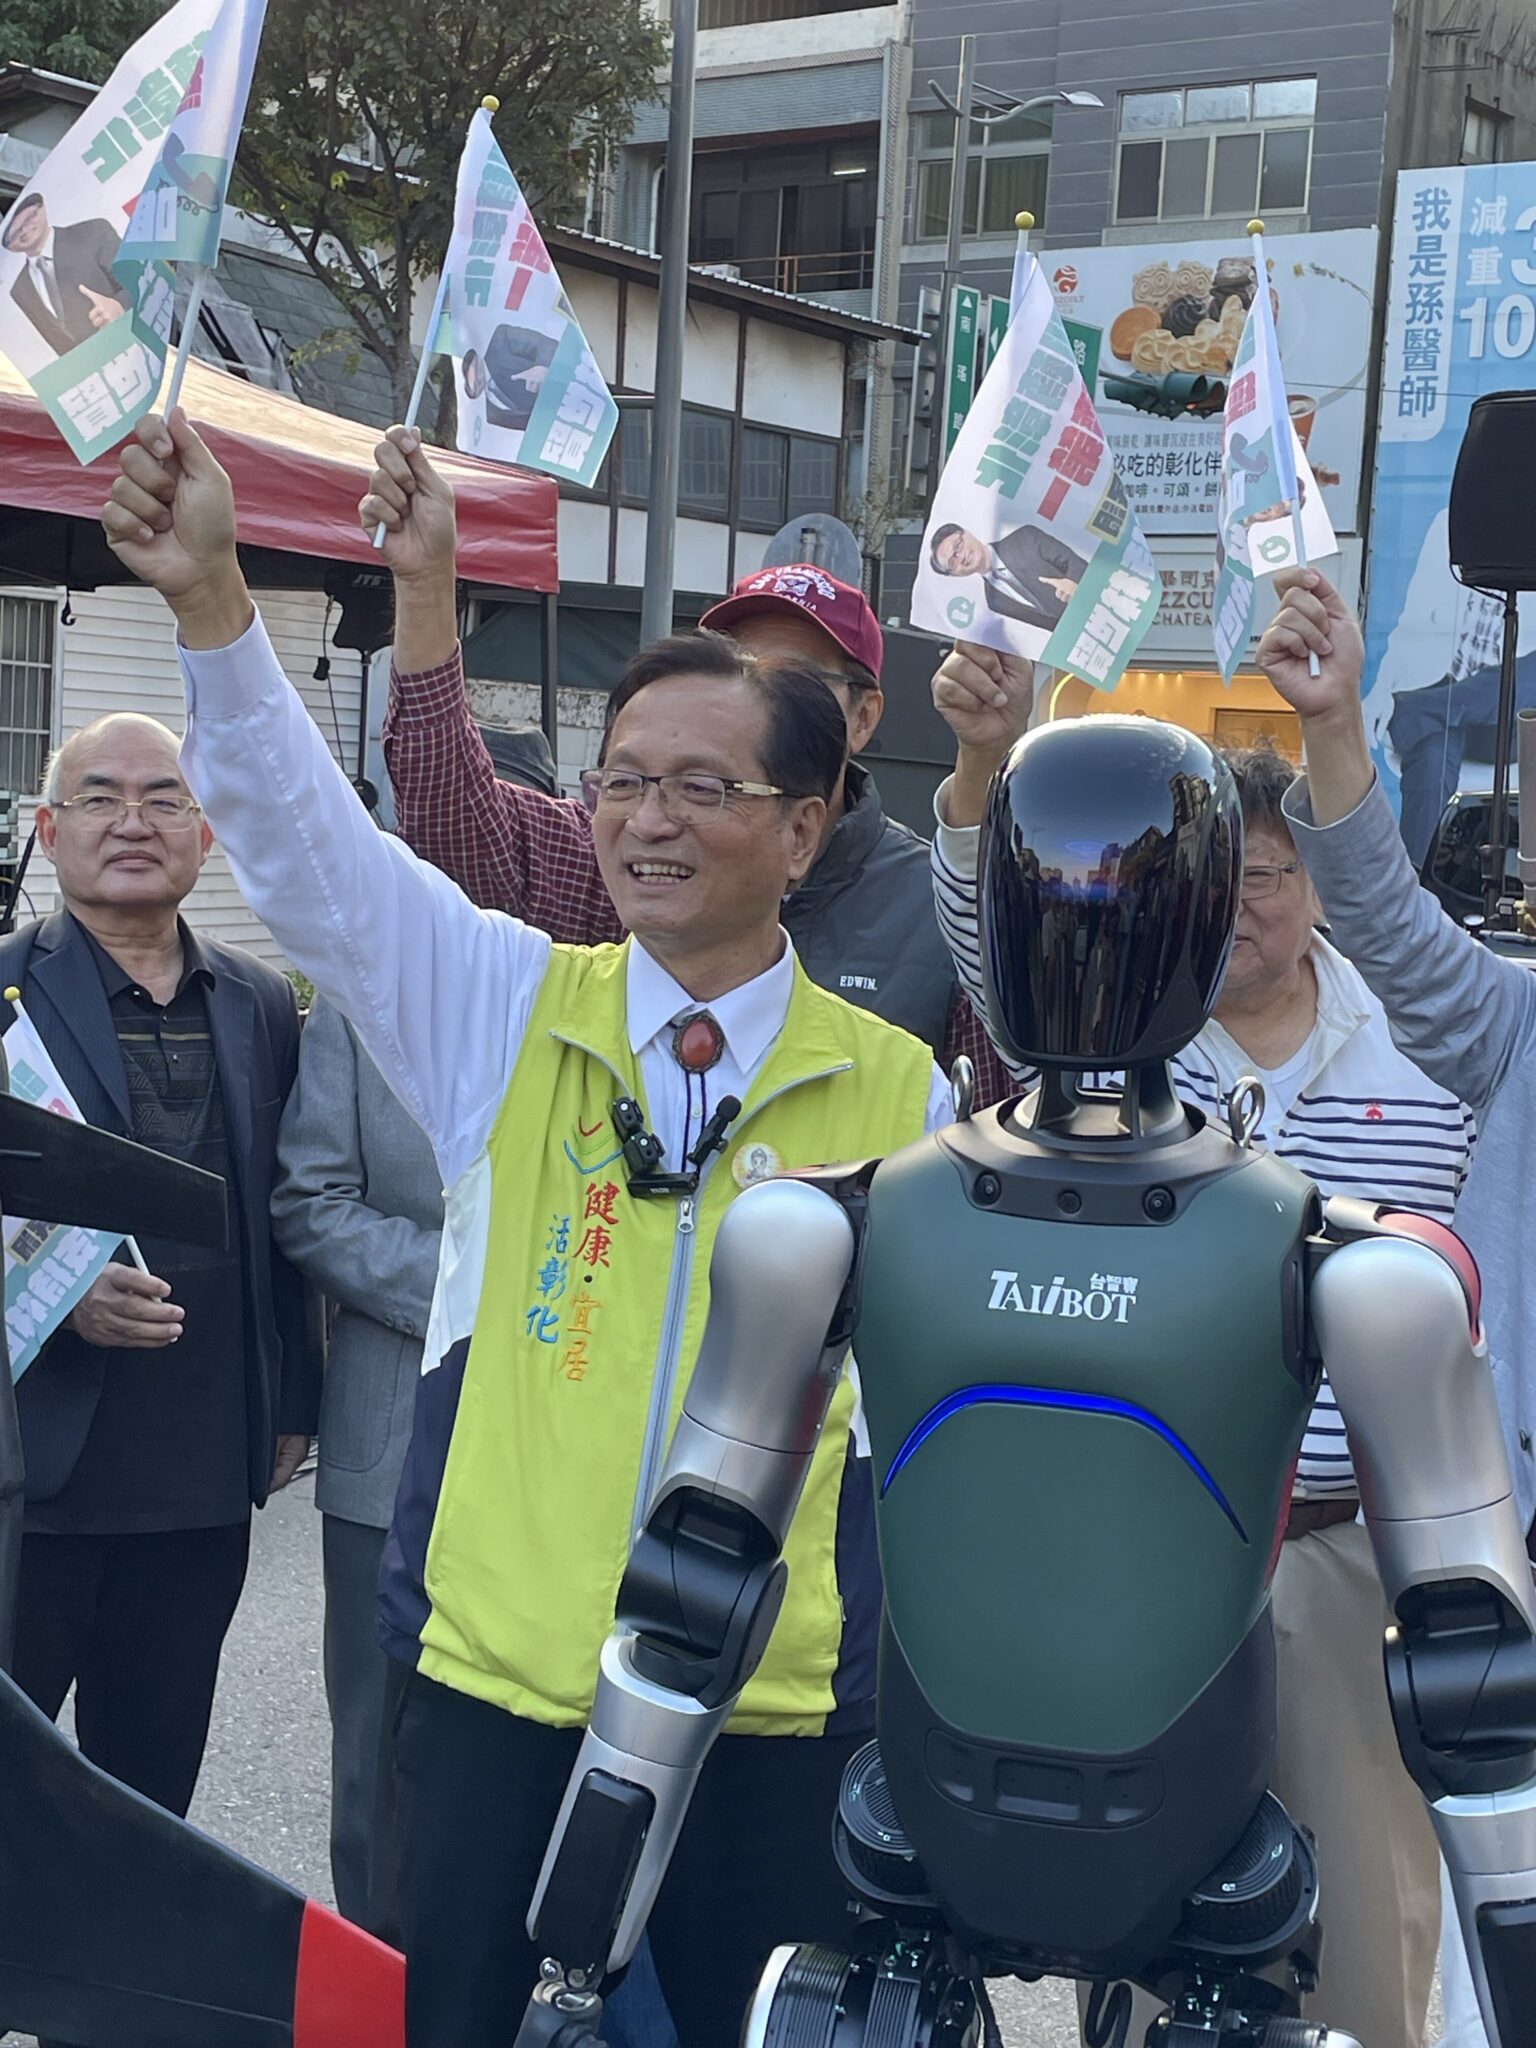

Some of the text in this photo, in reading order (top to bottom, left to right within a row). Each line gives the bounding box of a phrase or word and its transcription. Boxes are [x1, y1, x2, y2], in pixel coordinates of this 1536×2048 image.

[1466, 195, 1509, 286] 減重
[1398, 186, 1452, 418] 我是孫醫師
[840, 975, 877, 991] EDWIN
[525, 1213, 572, 1345] 活彰化
